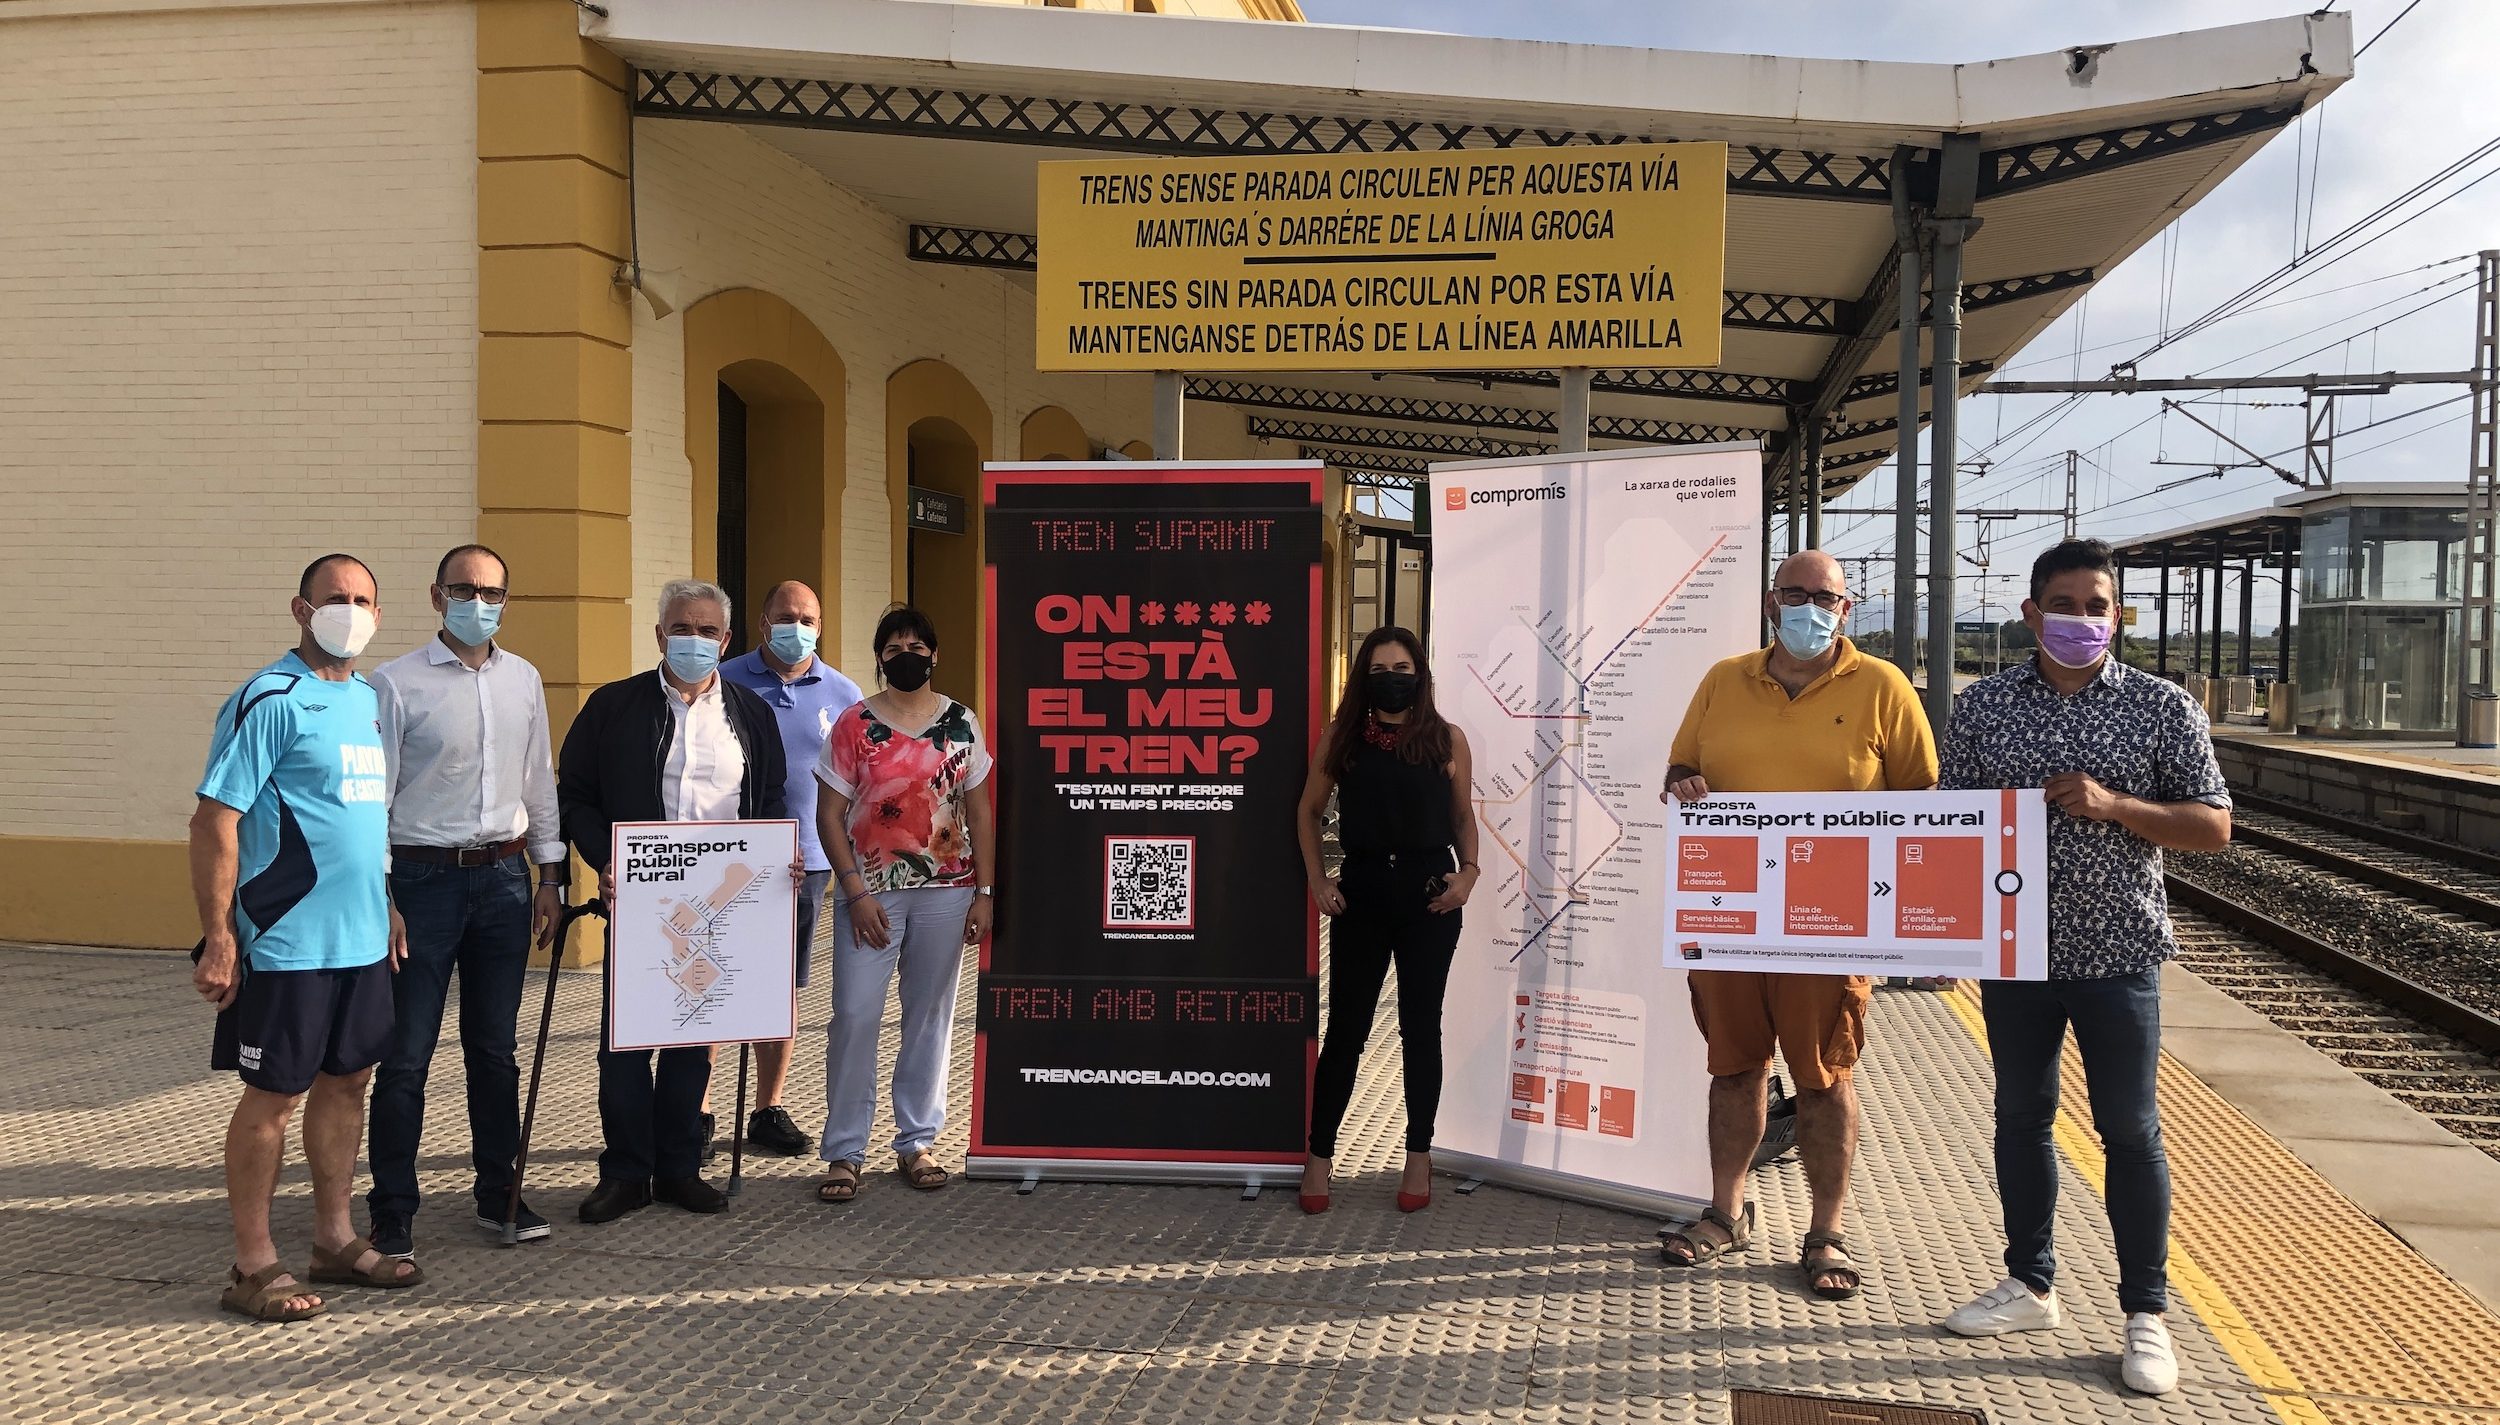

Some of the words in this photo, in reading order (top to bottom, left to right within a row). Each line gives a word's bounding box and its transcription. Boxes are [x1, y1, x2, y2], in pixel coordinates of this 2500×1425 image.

[1080, 173, 1153, 204] TRENS
[1160, 172, 1236, 203] SENSE
[1244, 170, 1331, 201] PARADA
[1340, 166, 1460, 200] CIRCULEN
[1468, 165, 1515, 196] PER
[1522, 161, 1633, 195] AQUESTA
[1642, 153, 1679, 192] VÍA
[1279, 208, 1383, 246] DARRÉRE
[1389, 214, 1421, 244] DE
[1428, 213, 1456, 243] LA
[1464, 205, 1523, 242] LÍNIA
[1532, 209, 1614, 240] GROGA
[1079, 280, 1177, 310] TRENES
[1187, 280, 1228, 309] SIN
[1239, 278, 1337, 308] PARADA
[1345, 276, 1480, 306] CIRCULAN
[1492, 274, 1545, 304] POR
[1556, 273, 1622, 303] ESTA
[1630, 265, 1674, 302] VÍA
[1068, 324, 1255, 354] MANTENGANSE
[1266, 316, 1363, 352] DETRÁS
[1375, 322, 1407, 352] DE
[1418, 321, 1449, 350] LA
[1460, 314, 1537, 350] LÍNEA
[1548, 319, 1682, 349] AMARILLA
[1625, 481, 1637, 490] La
[1640, 481, 1669, 490] xarxa
[1672, 479, 1686, 488] de
[1689, 476, 1736, 487] rodalies
[1471, 482, 1565, 506] compromís
[1677, 491, 1698, 502] que
[1701, 488, 1736, 498] volem
[1032, 520, 1115, 550] TREN
[1135, 520, 1275, 550] SUPRIMIT
[1035, 595, 1131, 633] ON
[1063, 629, 1237, 680] ESTÀ
[1028, 688, 1106, 727] EL
[1127, 688, 1273, 727] MEU
[1040, 735, 1259, 774] TREN?
[1055, 783, 1126, 795] T'ESTAN
[1131, 784, 1174, 795] FENT
[1179, 784, 1244, 796] PERDRE
[1070, 799, 1095, 811] UN
[1100, 799, 1157, 811] TEMPS
[1162, 797, 1233, 811] PRECIÓS
[1680, 802, 1756, 810] PROPOSTA
[1680, 810, 1815, 830] Transport
[1823, 810, 1905, 830] públic
[1914, 810, 1984, 826] rural
[627, 840, 747, 856] Transport
[626, 853, 697, 872] públic
[626, 869, 685, 882] rural
[1683, 870, 1722, 879] Transport
[1689, 878, 1726, 886] demanda
[1593, 898, 1618, 906] Alacant
[1812, 906, 1822, 914] de
[1902, 906, 1934, 914] Estació
[1790, 914, 1805, 922] bus
[1902, 915, 1936, 924] d'enllaç
[1790, 922, 1854, 931] interconectada
[1911, 923, 1946, 932] rodalies
[1103, 932, 1194, 941] TRENCANCELADO.COM
[1492, 939, 1519, 947] Orihuela
[1553, 958, 1584, 967] Torrevieja
[1535, 990, 1560, 1000] Targeta
[1561, 993, 1580, 1001] única
[990, 987, 1073, 1019] TREN
[1092, 989, 1155, 1020] AMB
[1176, 990, 1304, 1022] RETARD
[1513, 1061, 1544, 1072] Transport
[1545, 1065, 1566, 1074] públic
[1020, 1068, 1271, 1087] TRENCANCELADO.COM
